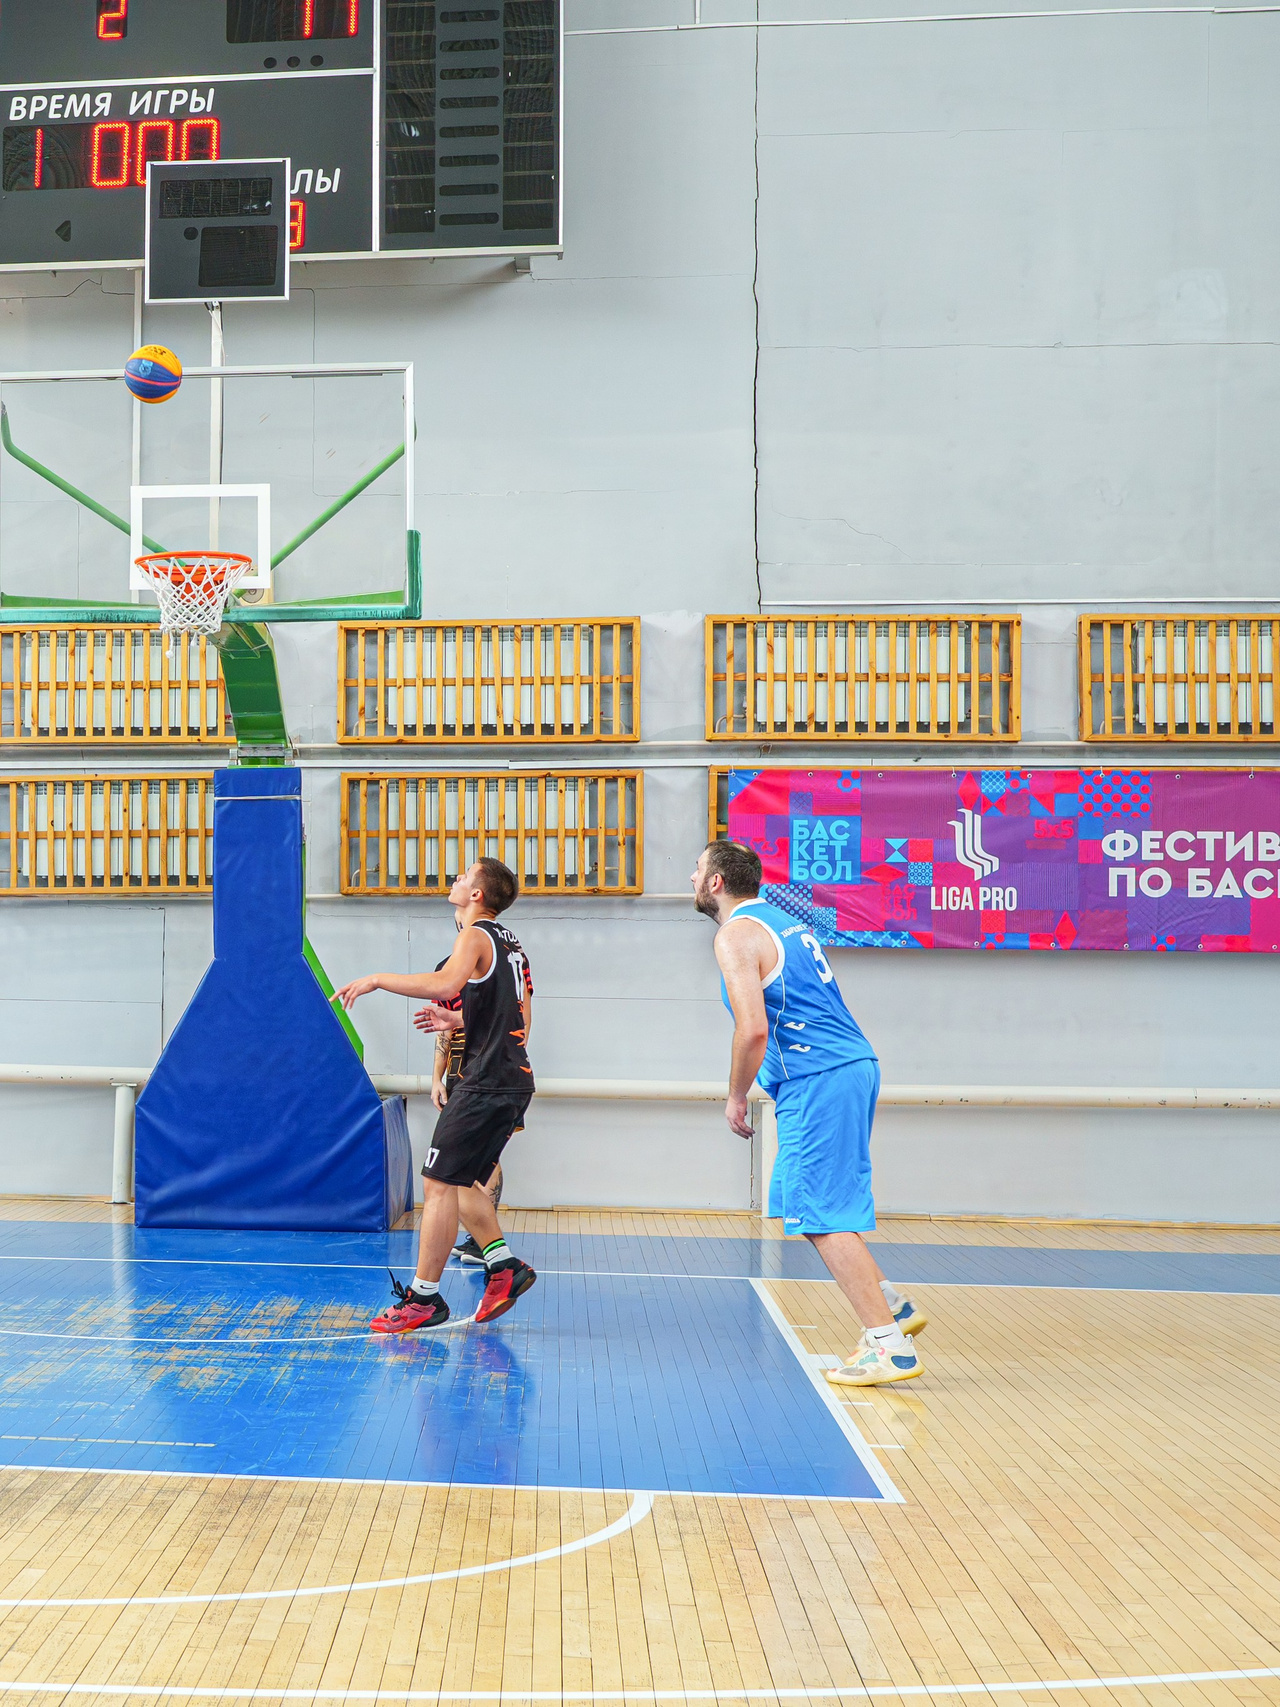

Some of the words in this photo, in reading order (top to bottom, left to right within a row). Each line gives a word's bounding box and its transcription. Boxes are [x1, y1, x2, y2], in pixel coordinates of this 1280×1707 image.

[9, 92, 113, 121] ВРЕМЯ
[129, 88, 216, 115] ИГРЫ
[290, 168, 341, 194] ЛЫ
[792, 819, 851, 840] БАС
[1033, 820, 1074, 838] 5x5
[792, 840, 848, 860] КЕТ
[792, 860, 852, 881] БОЛ
[1109, 867, 1172, 897] ПО
[1188, 867, 1280, 898] БАС
[930, 887, 974, 911] LIGA
[979, 887, 1018, 911] PRO
[800, 933, 833, 983] 3
